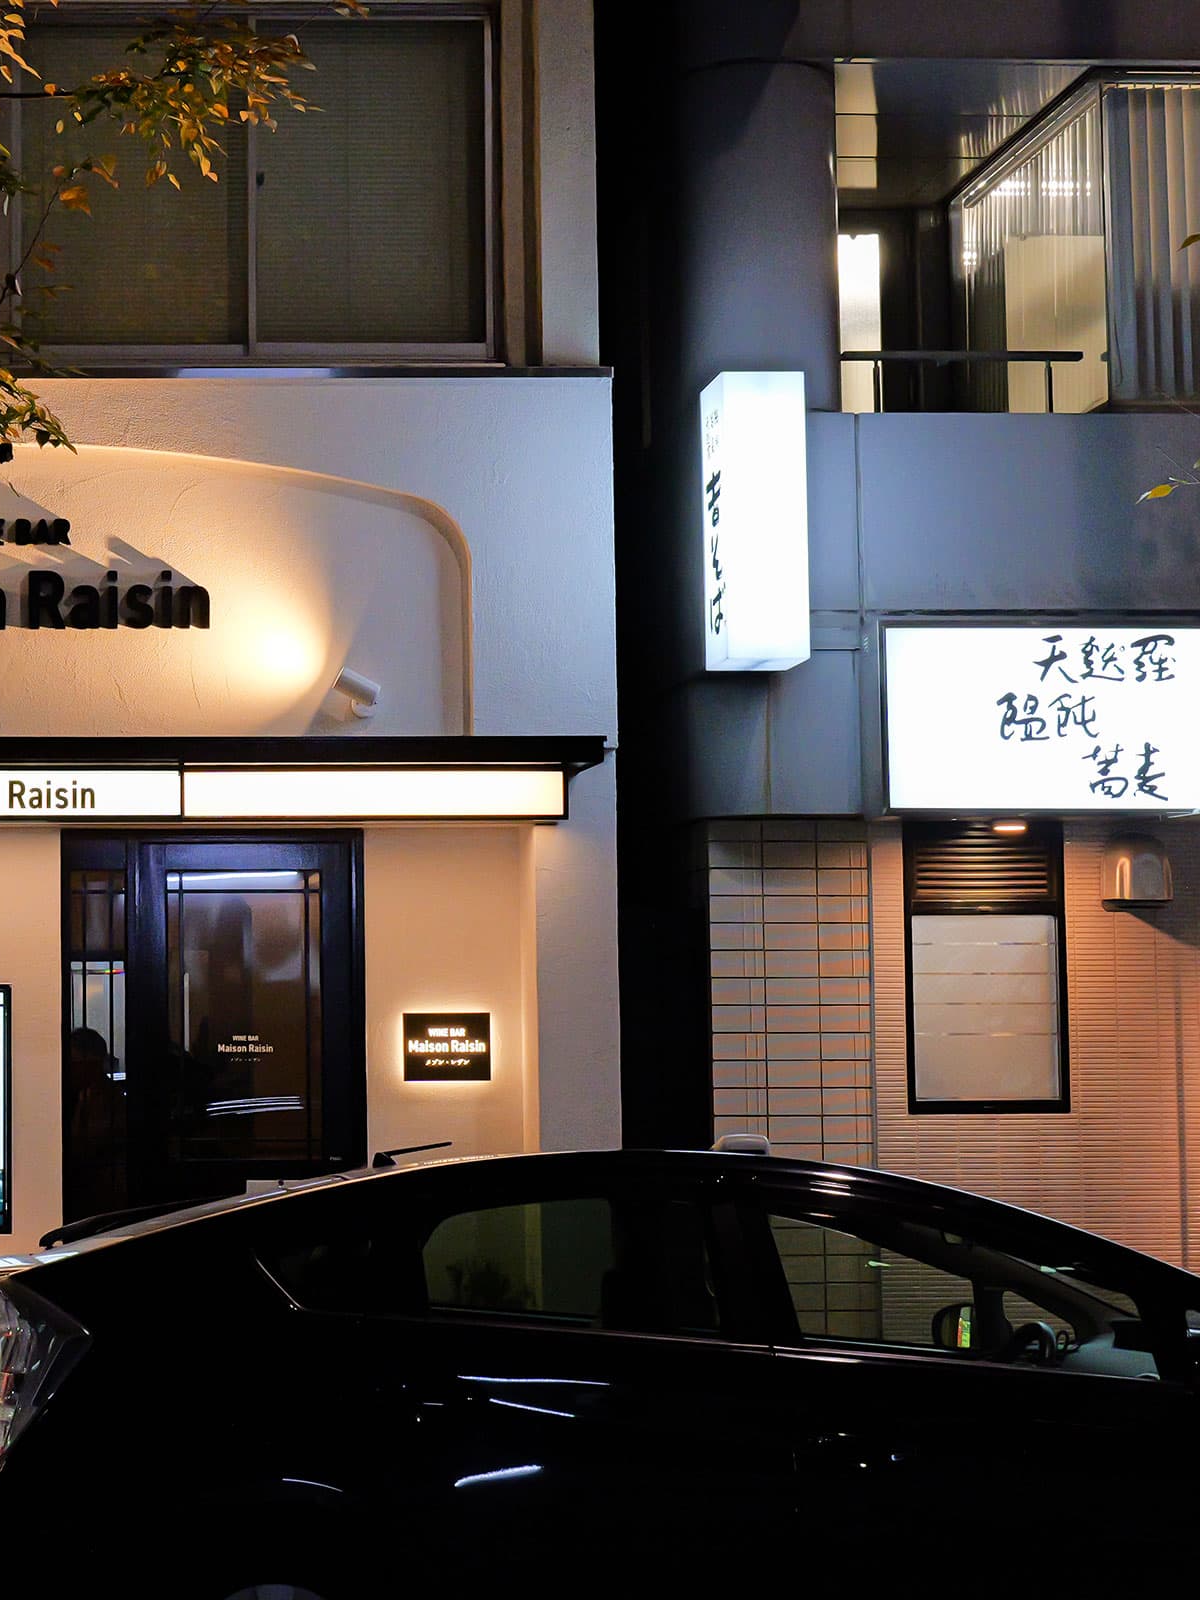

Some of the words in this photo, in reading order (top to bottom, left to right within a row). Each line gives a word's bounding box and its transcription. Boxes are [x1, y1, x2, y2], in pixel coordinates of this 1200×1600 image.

[15, 518, 72, 546] BAR
[28, 570, 211, 630] Raisin
[8, 780, 96, 809] Raisin
[428, 1027, 449, 1037] WINE
[450, 1027, 466, 1037] BAR
[217, 1043, 247, 1053] Maison
[248, 1043, 274, 1053] Raisin
[408, 1039, 449, 1053] Maison
[450, 1039, 486, 1053] Raisin
